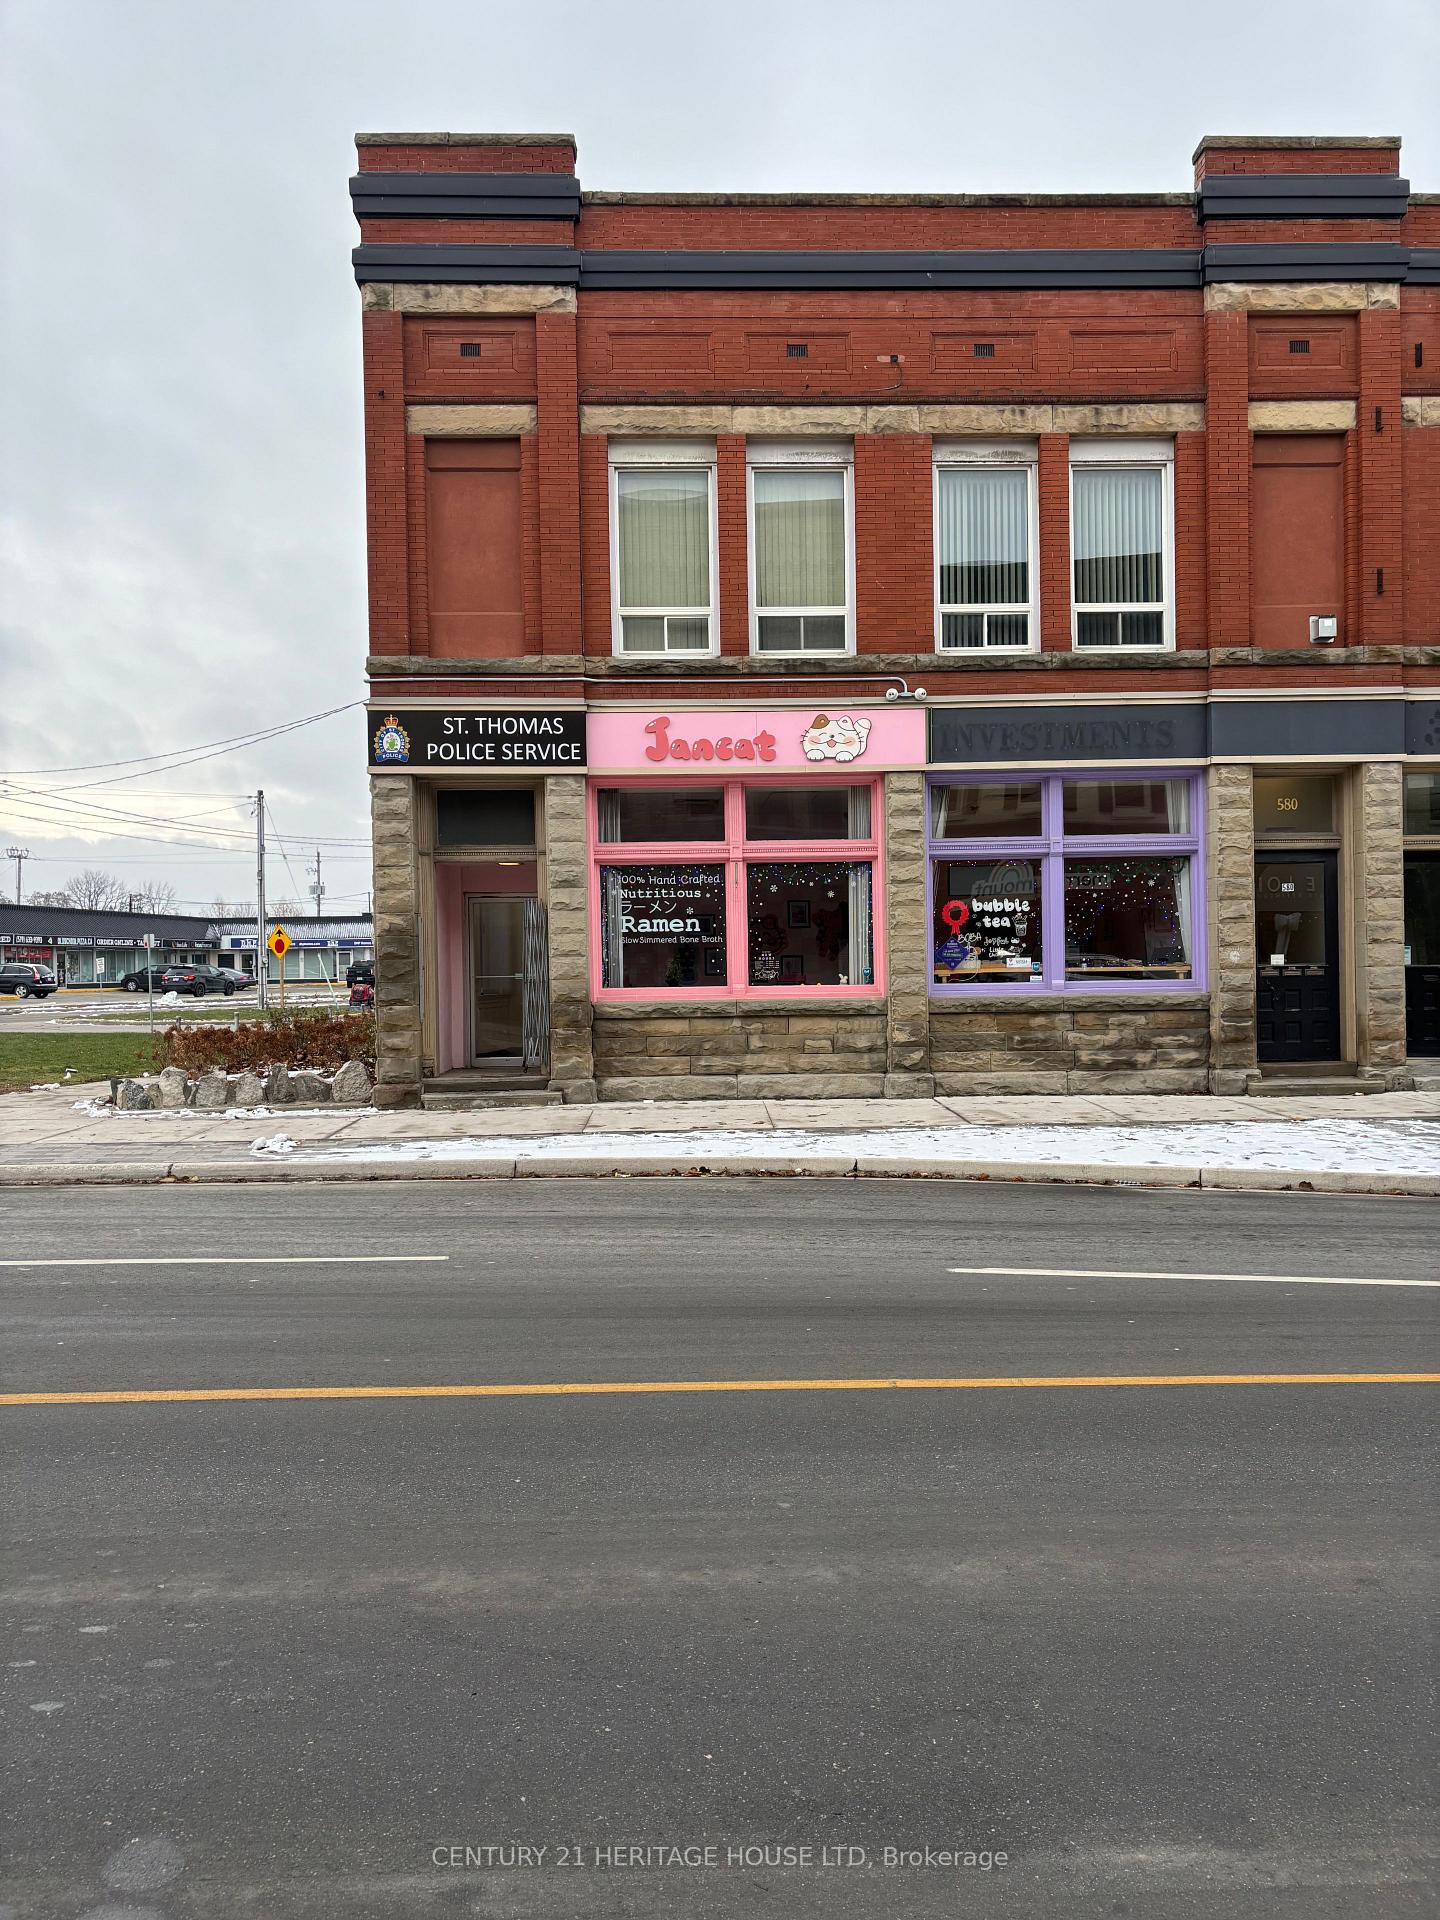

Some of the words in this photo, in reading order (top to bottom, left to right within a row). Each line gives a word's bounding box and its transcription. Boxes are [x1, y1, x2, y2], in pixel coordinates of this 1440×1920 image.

[443, 717, 469, 735] ST.
[475, 717, 564, 735] THOMAS
[645, 715, 777, 762] Jancat
[938, 719, 1175, 753] INVESTMENTS
[427, 743, 496, 760] POLICE
[501, 743, 581, 760] SERVICE
[1277, 798, 1298, 811] 580
[649, 875, 677, 885] Hand
[680, 874, 721, 887] Crafted
[620, 888, 701, 899] Nutritious
[620, 900, 677, 914] ラーメン
[971, 898, 1031, 913] bubble
[621, 915, 701, 933] Ramen
[982, 915, 1011, 928] tea
[639, 936, 677, 944] Simmered
[701, 935, 723, 943] Broth
